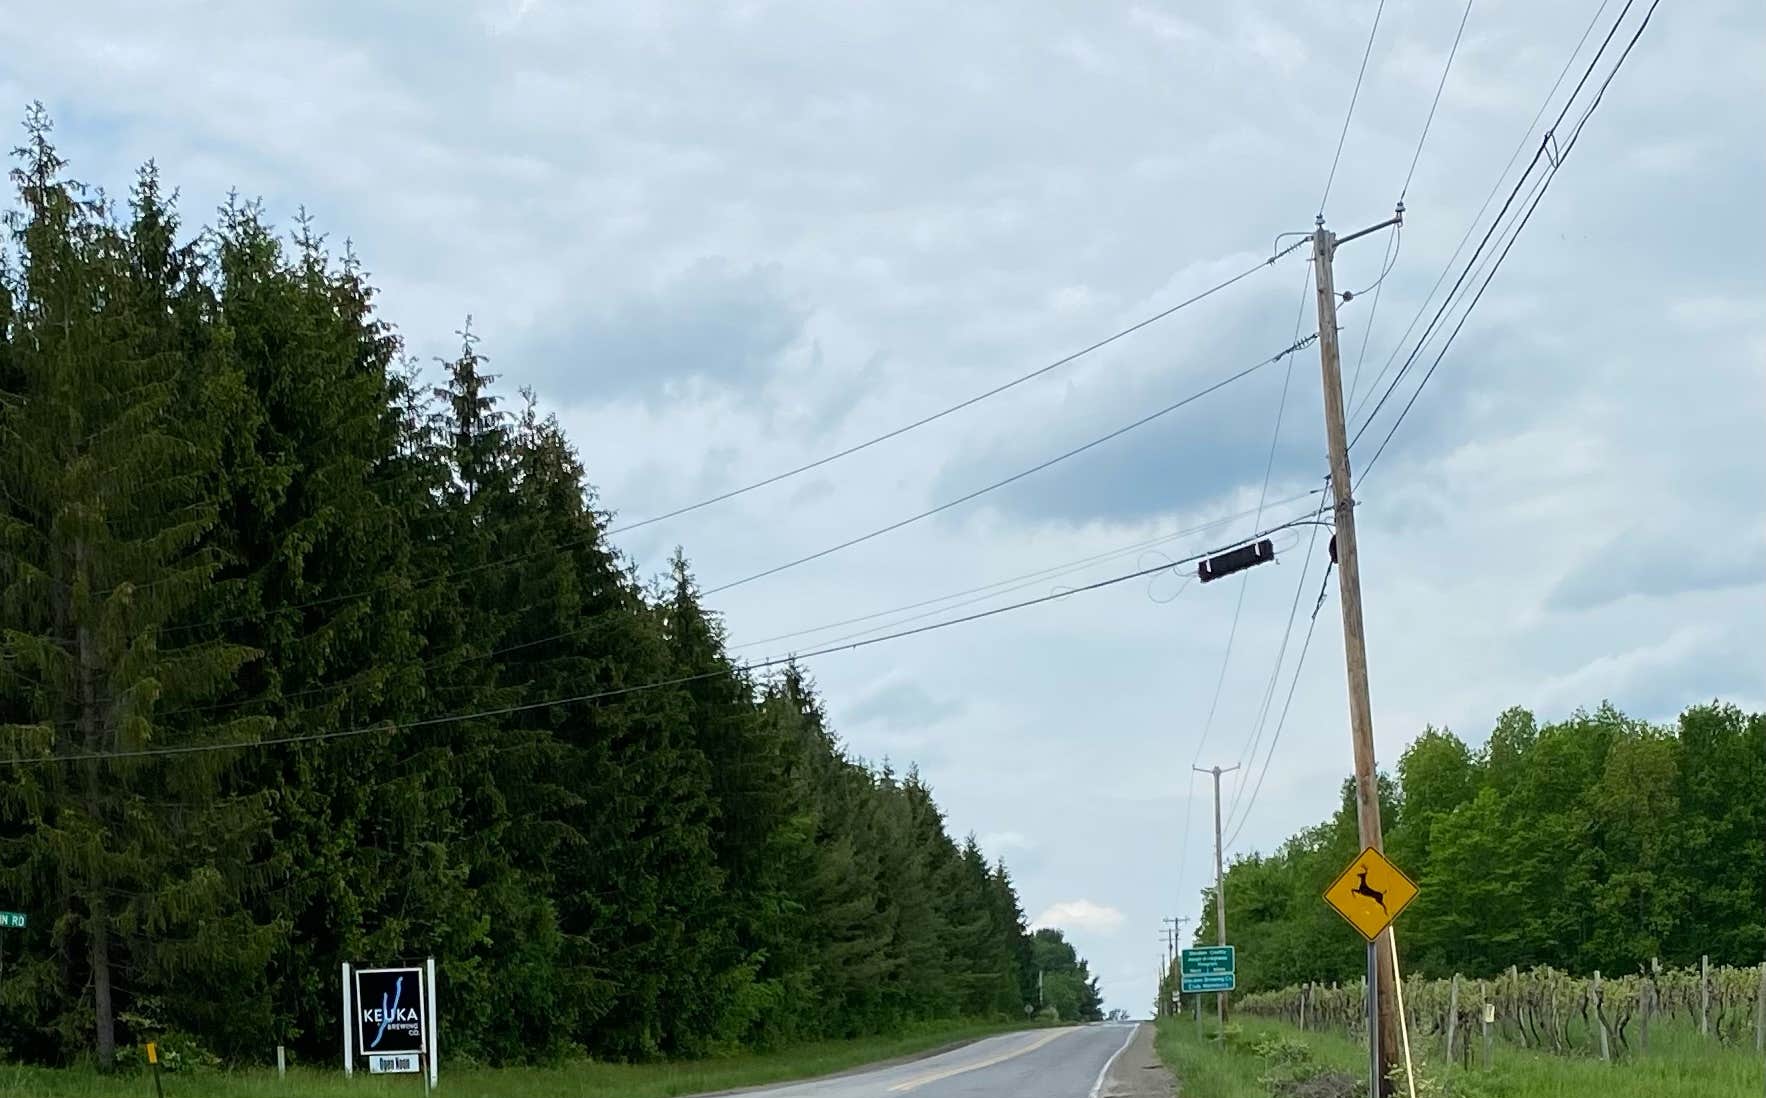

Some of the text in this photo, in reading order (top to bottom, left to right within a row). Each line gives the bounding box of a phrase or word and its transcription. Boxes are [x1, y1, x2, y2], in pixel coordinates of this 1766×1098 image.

[12, 915, 25, 927] RD
[363, 1007, 418, 1023] KEUKA
[387, 1022, 419, 1030] BREWING
